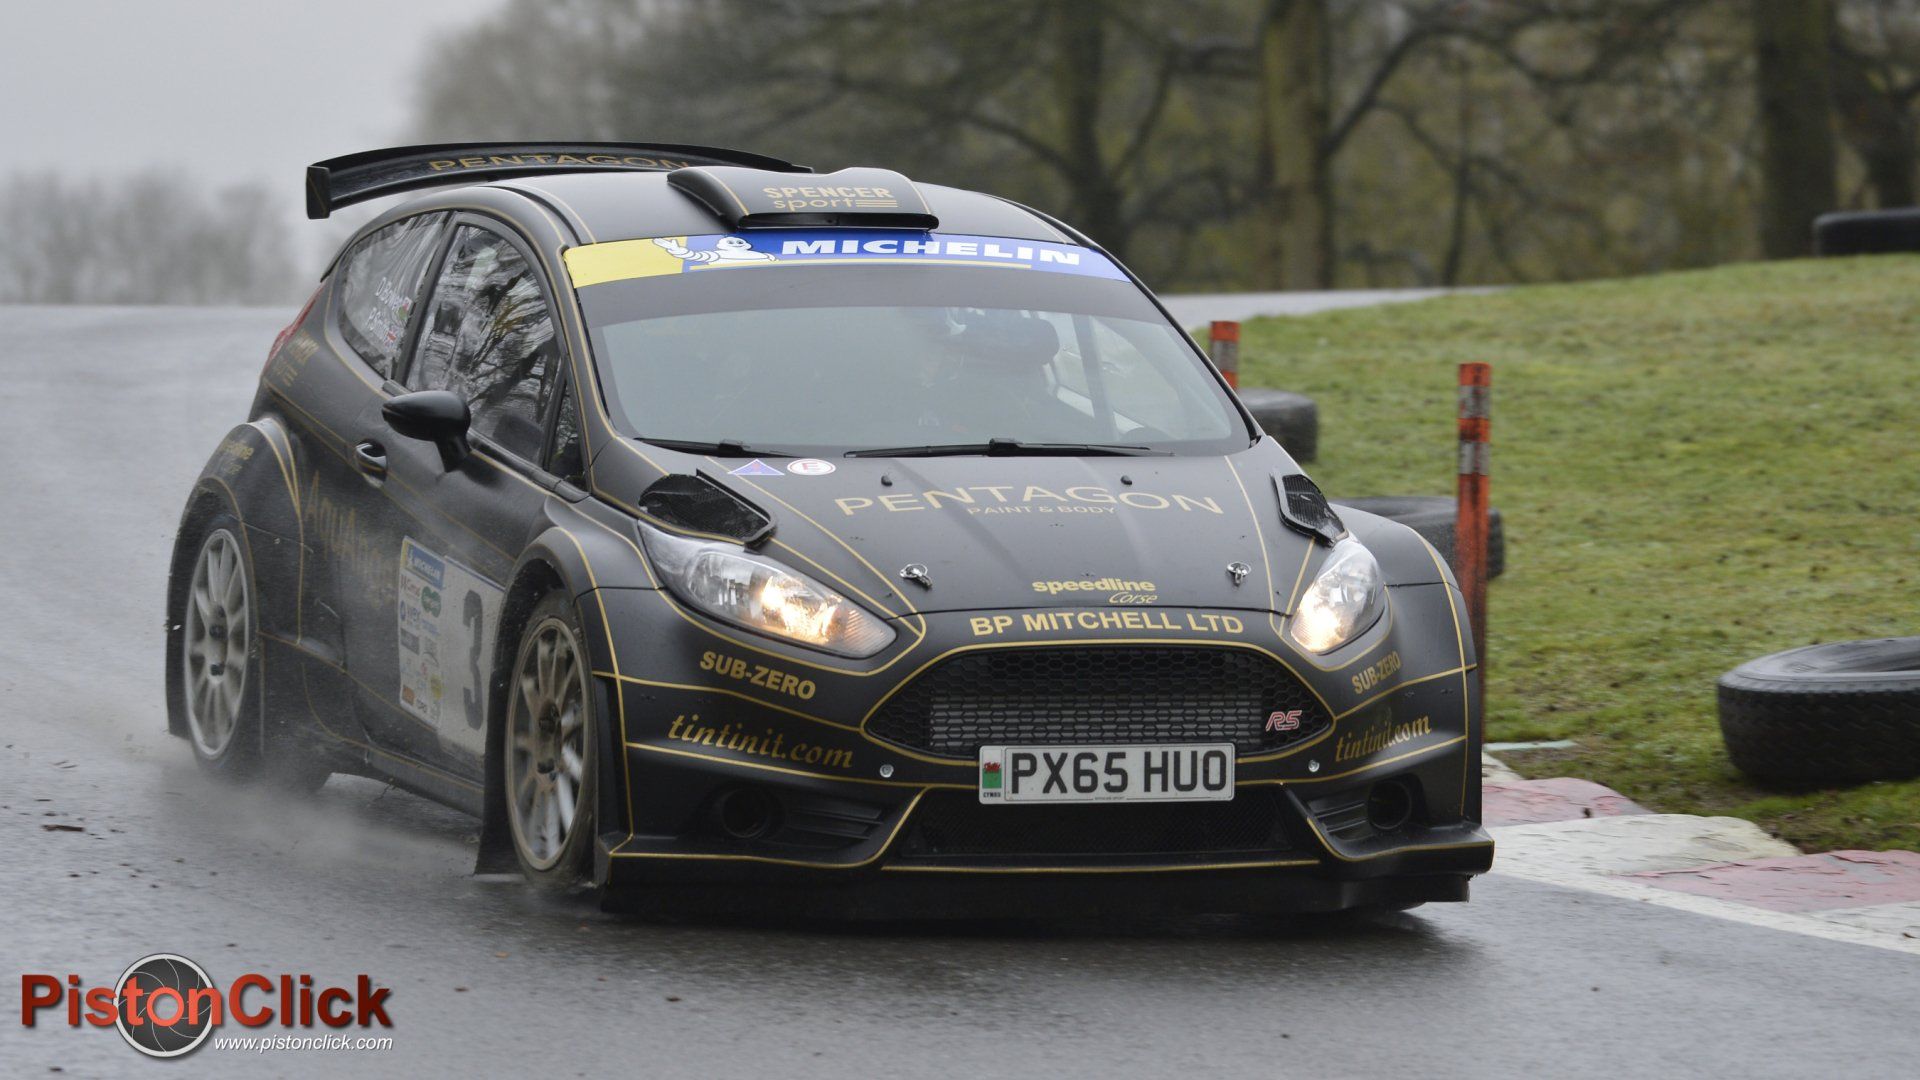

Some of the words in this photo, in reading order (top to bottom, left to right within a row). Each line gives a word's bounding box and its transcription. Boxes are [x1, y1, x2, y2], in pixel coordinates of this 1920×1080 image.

[429, 154, 690, 172] PENTAGON
[763, 187, 895, 199] SPENCER
[773, 197, 853, 212] sport
[780, 239, 1081, 265] MICHELIN
[835, 486, 1225, 516] PENTAGON
[967, 505, 1033, 515] PAINT
[1061, 504, 1118, 515] BODY
[1032, 577, 1156, 595] speedline
[1109, 591, 1158, 605] Corse
[969, 614, 1014, 637] BP
[1022, 610, 1182, 633] MITCHELL
[1186, 612, 1245, 634] LTD
[462, 589, 484, 731] 3
[1351, 650, 1402, 695] SUB-ZERO
[700, 650, 816, 700] SUB-ZERO
[667, 713, 853, 769] tintinit.com
[1335, 714, 1433, 763] tintinit.com
[1011, 751, 1129, 795] PX65
[1143, 750, 1228, 793] HUO
